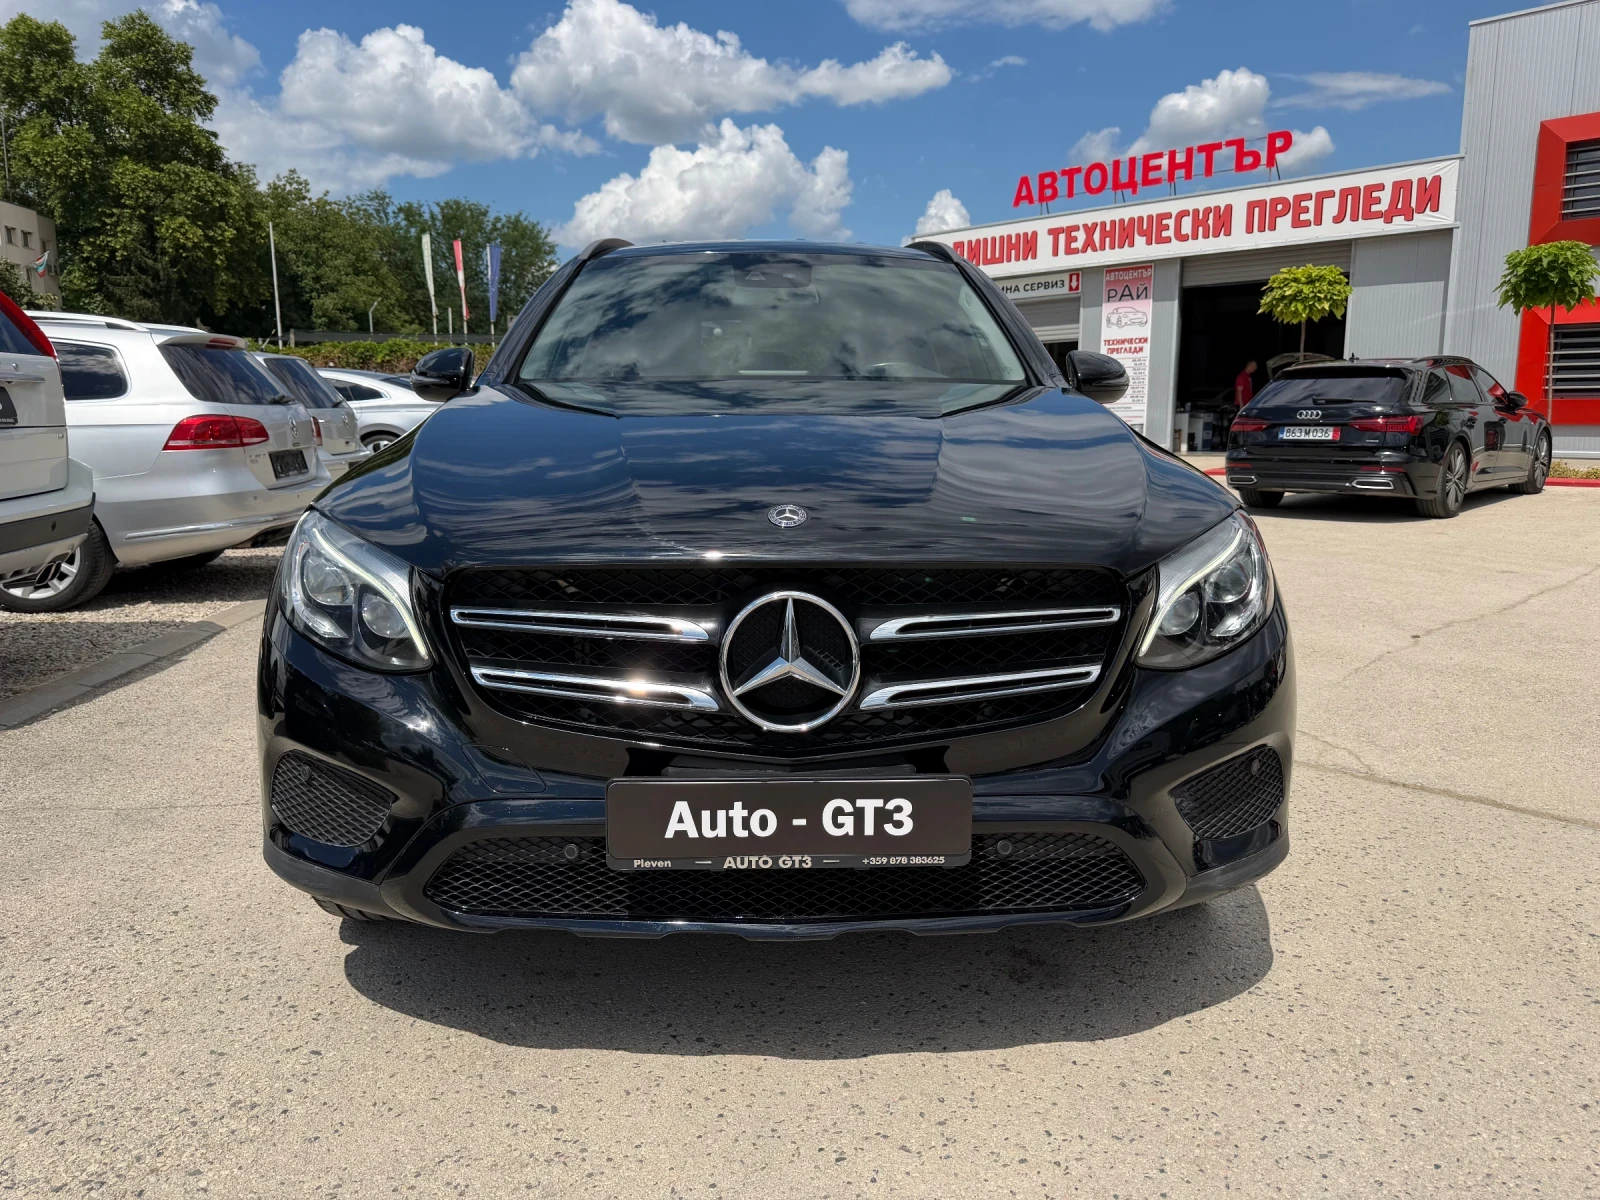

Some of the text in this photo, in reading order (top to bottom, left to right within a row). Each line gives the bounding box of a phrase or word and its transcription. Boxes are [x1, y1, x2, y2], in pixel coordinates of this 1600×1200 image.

[1012, 130, 1293, 207] АВТОЦЕНТЪР
[1047, 203, 1233, 257] ТЕХНИЧЕСКИ
[1245, 174, 1442, 234] ПРЕГЛЕДИ
[1106, 268, 1152, 280] АВТОЦЕНТЪР
[1023, 279, 1065, 292] СЕРВИЗ
[1107, 282, 1148, 302] РАЙ
[1103, 337, 1148, 346] ТЕХНИЧЕСКИ
[1107, 346, 1144, 355] ПРЕГЛЕДИ
[664, 800, 778, 838] Auto
[822, 798, 914, 837] GT3
[633, 859, 672, 868] Pleven
[723, 855, 773, 869] AUTO
[778, 854, 812, 868] GT3
[862, 856, 888, 865] +359
[889, 856, 908, 865] 878
